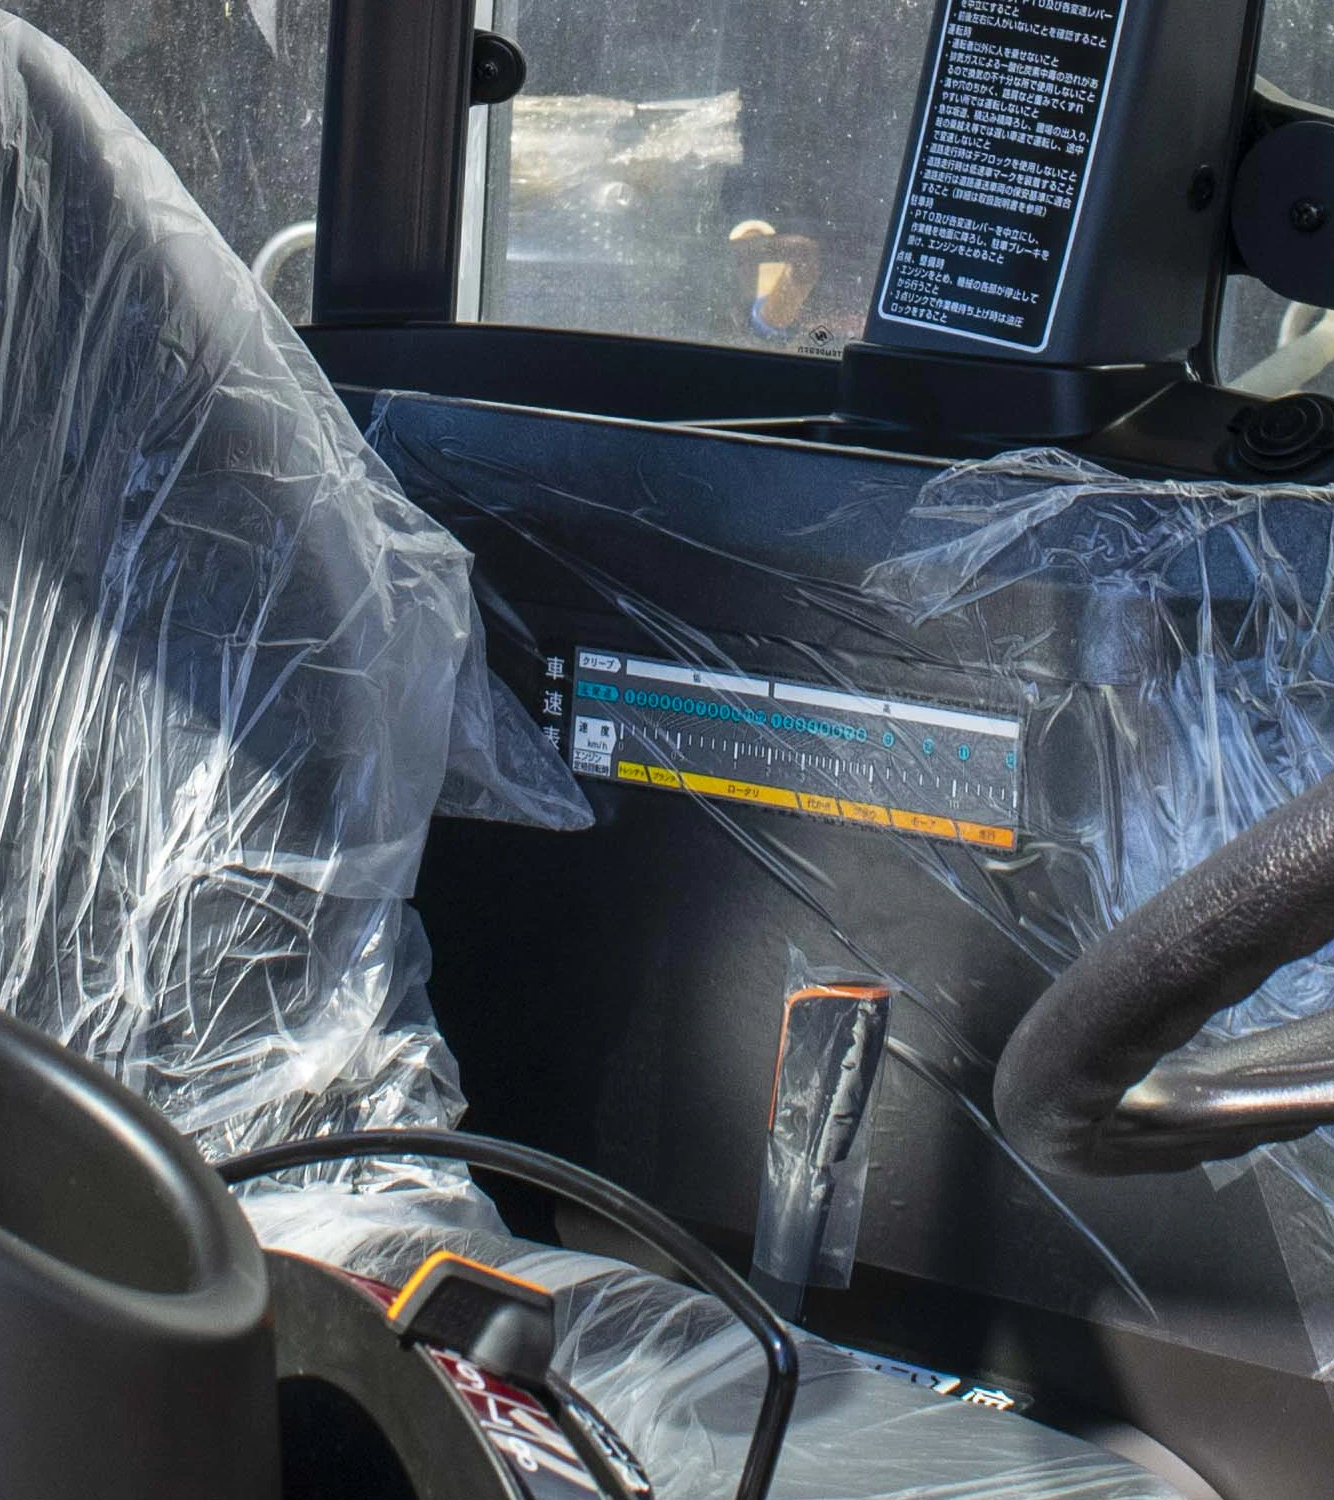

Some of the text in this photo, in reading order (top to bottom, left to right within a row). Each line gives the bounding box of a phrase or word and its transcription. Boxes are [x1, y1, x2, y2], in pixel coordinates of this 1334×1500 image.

[947, 22, 972, 38] 運転時
[941, 90, 1039, 118] やすい所では運転しないこと
[932, 129, 991, 150] で変速しないこと
[897, 276, 939, 295] から行うこと
[890, 301, 948, 324] ロックをすること
[587, 738, 607, 751] km/h
[574, 750, 601, 763] エンジン
[727, 783, 759, 799] ロータリ
[508, 1437, 538, 1472] 8
